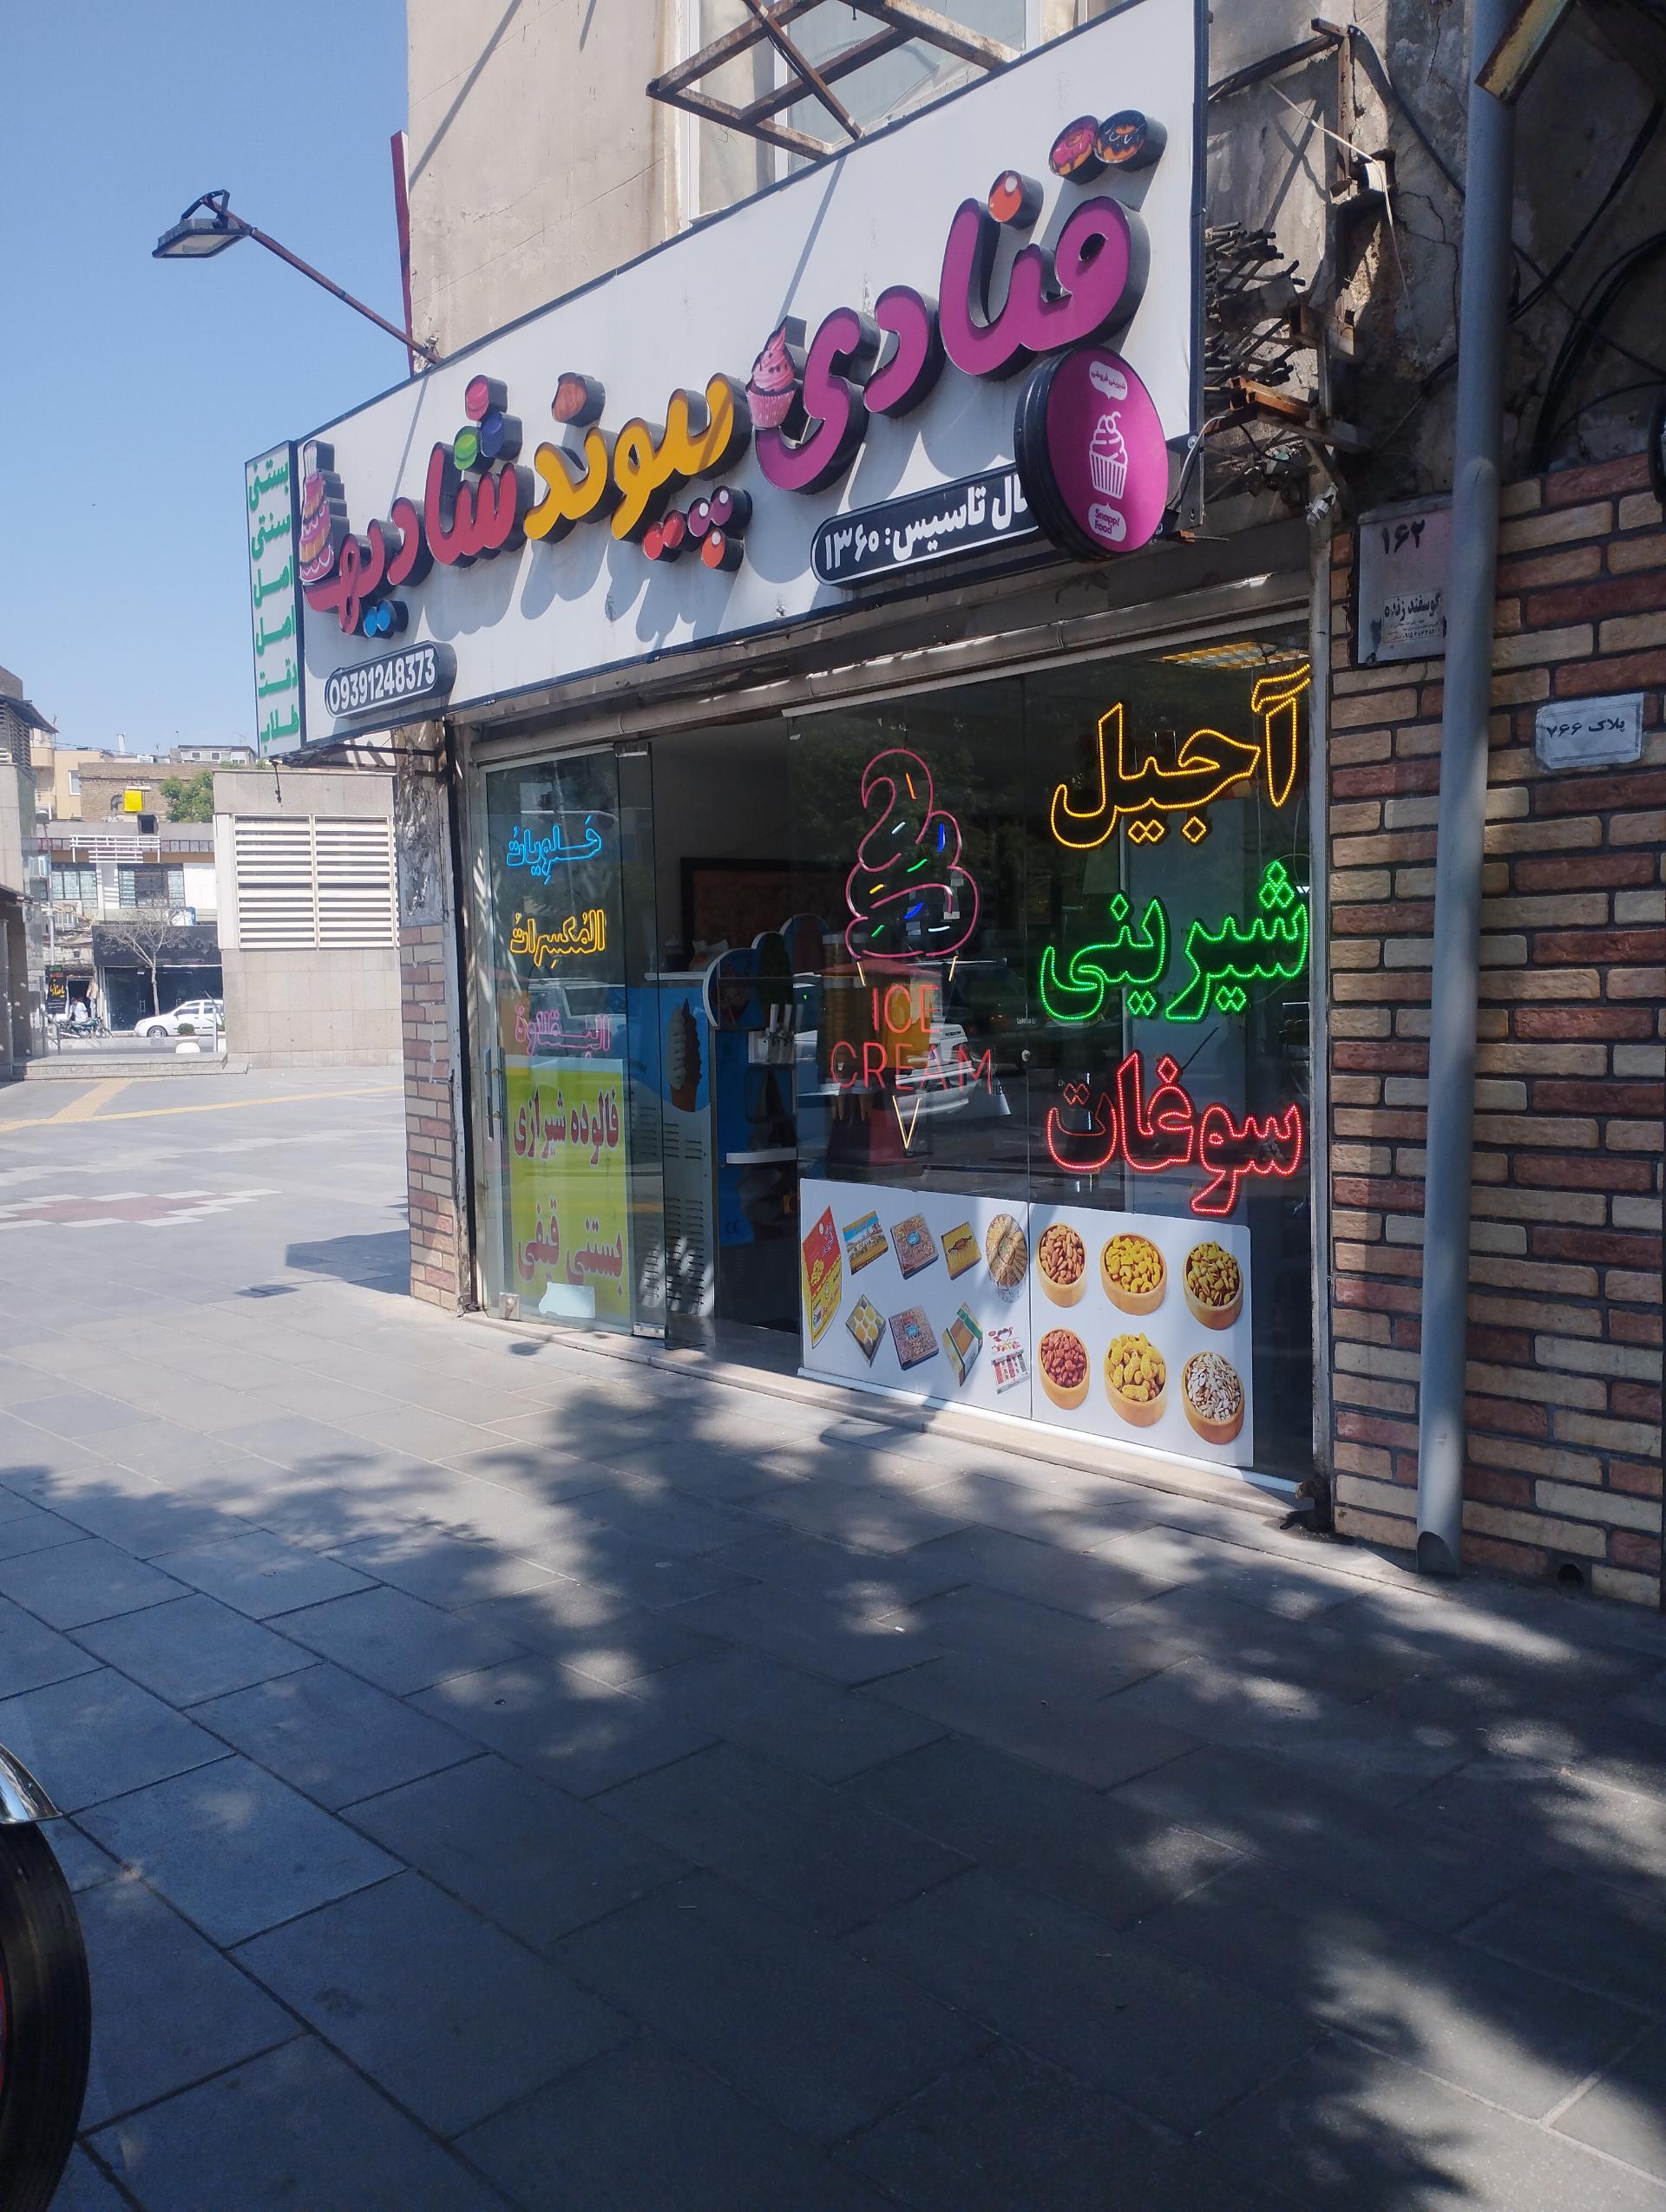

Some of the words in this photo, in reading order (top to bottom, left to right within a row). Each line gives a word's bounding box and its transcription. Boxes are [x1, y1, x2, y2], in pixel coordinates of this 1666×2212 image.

[751, 110, 1150, 492] قنادی
[249, 458, 289, 511] بستنی
[523, 371, 738, 570] پیوند
[992, 474, 1028, 530] ال
[1095, 507, 1119, 527] Snapp!
[1095, 519, 1112, 534] Food
[252, 512, 291, 560] سنتی
[825, 524, 879, 570] ۱۳۶۰
[253, 555, 293, 607] اصل
[256, 605, 296, 656] اصل
[329, 648, 436, 712] 09391248373
[260, 704, 300, 753] طلاب
[1546, 722, 1583, 738] ۷۶۶
[1588, 717, 1625, 733] پلاک
[1050, 664, 1311, 848] آجیل
[1040, 860, 1309, 1022] شیرینی
[872, 985, 941, 1036] ICE
[830, 1040, 994, 1096] CREAM
[513, 1087, 567, 1160] شیرازی
[570, 1088, 620, 1167] فالوده
[1046, 1050, 1304, 1214] سوغات
[517, 1198, 560, 1284] قیفی
[566, 1217, 623, 1299] بستنی
